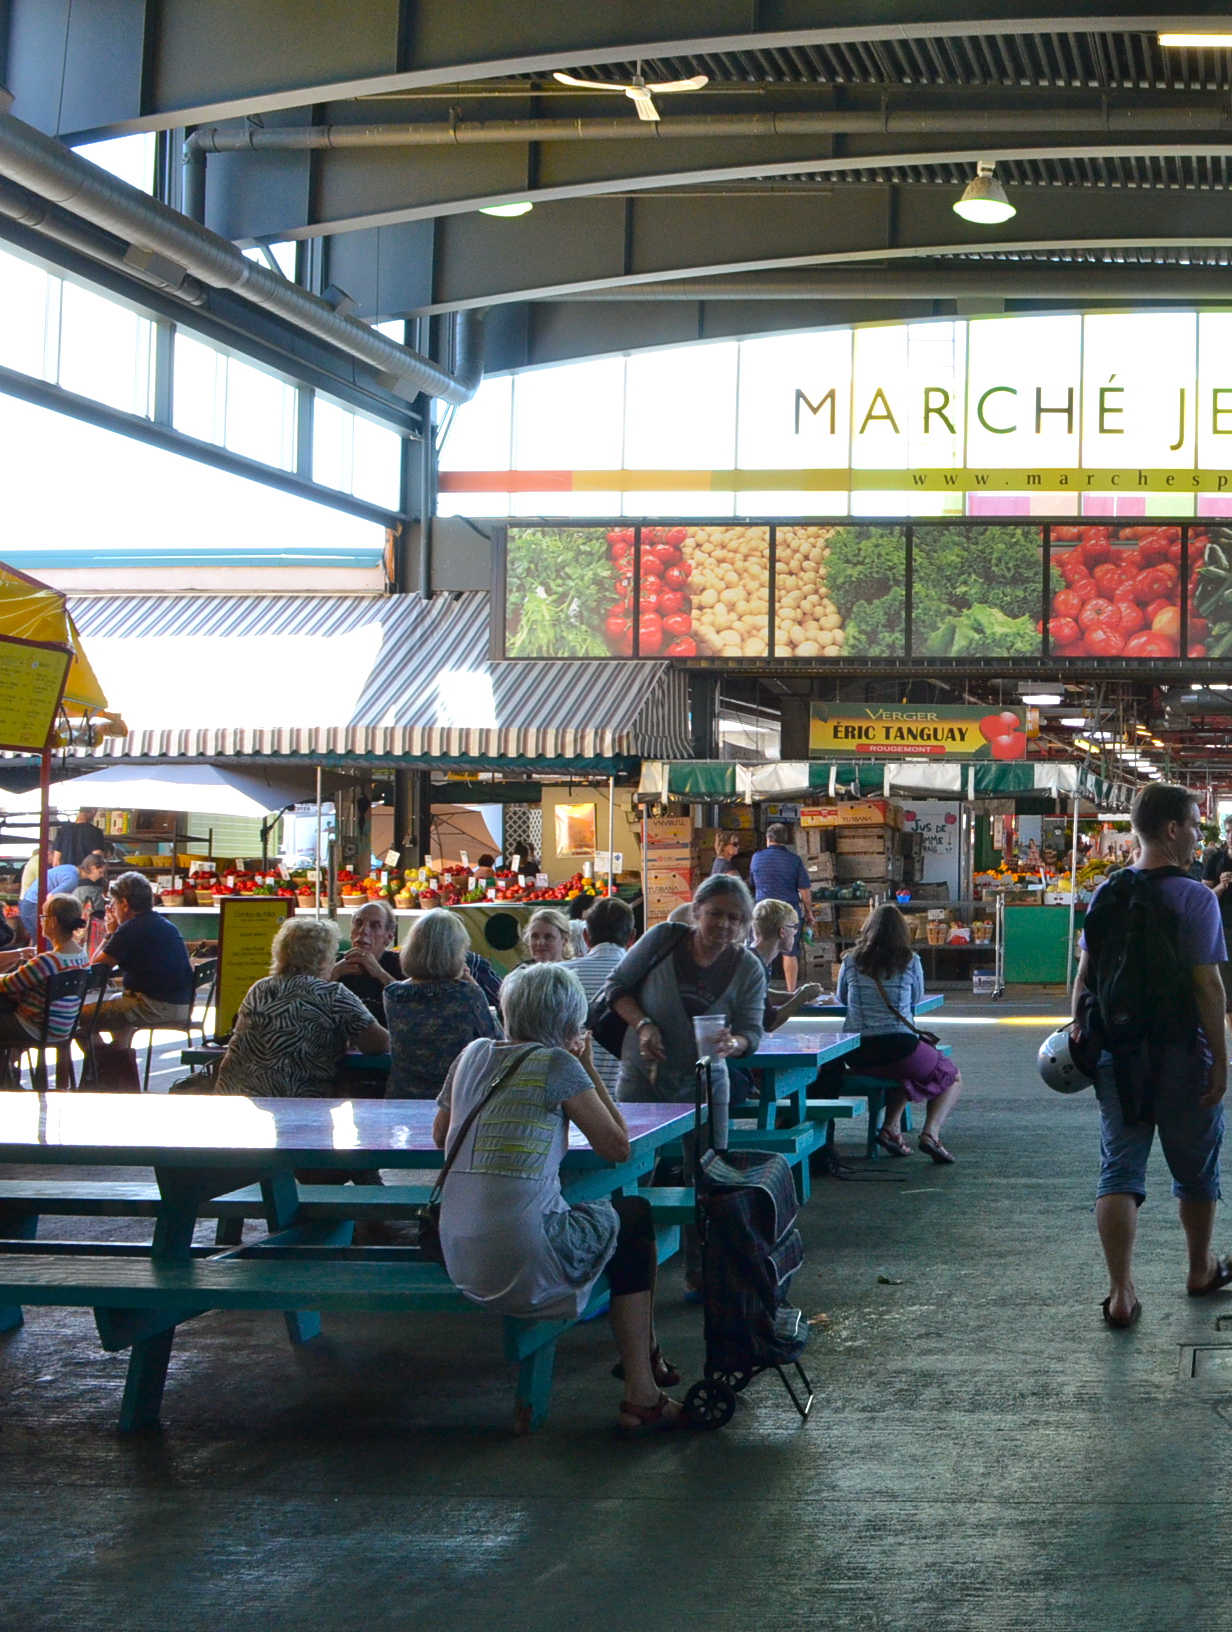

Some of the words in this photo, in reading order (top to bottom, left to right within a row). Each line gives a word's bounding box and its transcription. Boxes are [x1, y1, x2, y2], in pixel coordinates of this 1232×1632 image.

[795, 374, 1124, 434] MARCHÉ
[833, 722, 876, 740] ÉRIC
[882, 725, 969, 742] TANGUAY
[869, 745, 932, 753] ROUGEMONT
[936, 825, 947, 833] DE
[922, 835, 944, 845] MME
[922, 845, 938, 853] RAIS
